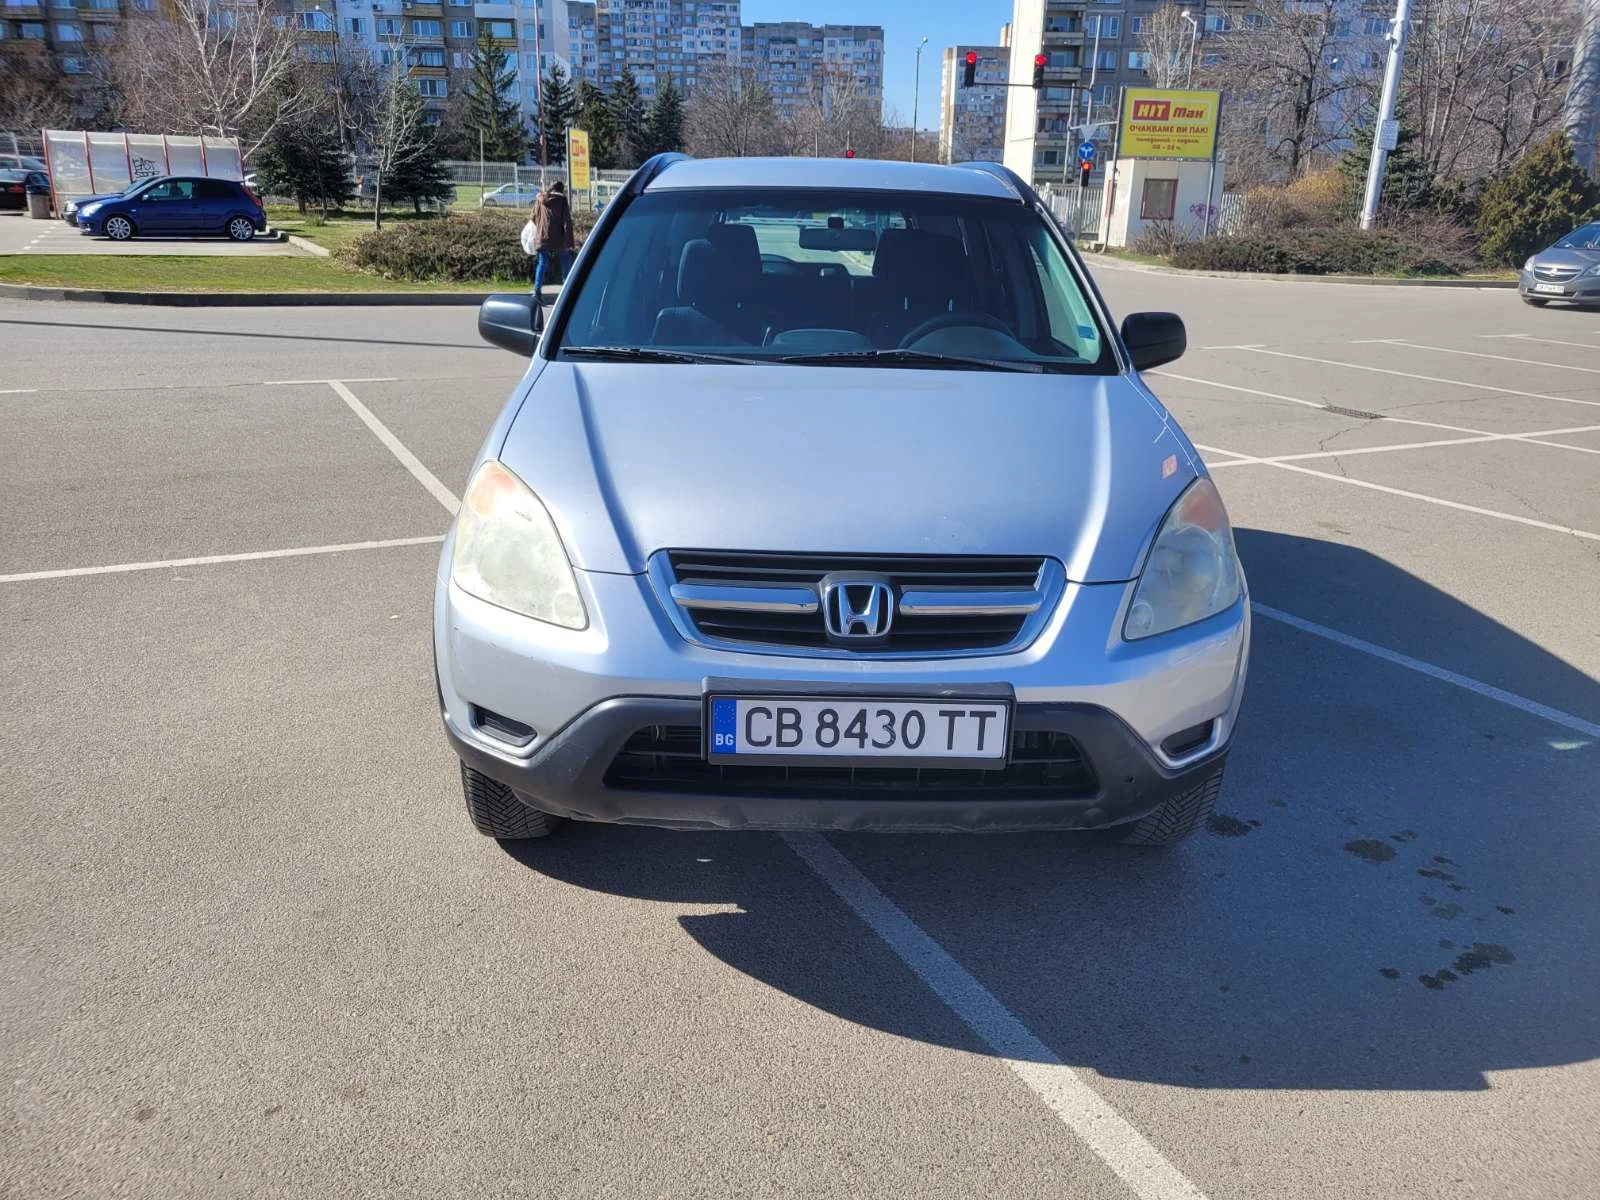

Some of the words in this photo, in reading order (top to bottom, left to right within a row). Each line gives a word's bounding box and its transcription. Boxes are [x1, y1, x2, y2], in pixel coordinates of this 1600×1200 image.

[1137, 103, 1167, 118] HIT
[745, 706, 804, 748] CB
[814, 708, 926, 750] 8430
[938, 709, 997, 751] TT
[715, 733, 734, 746] BG
